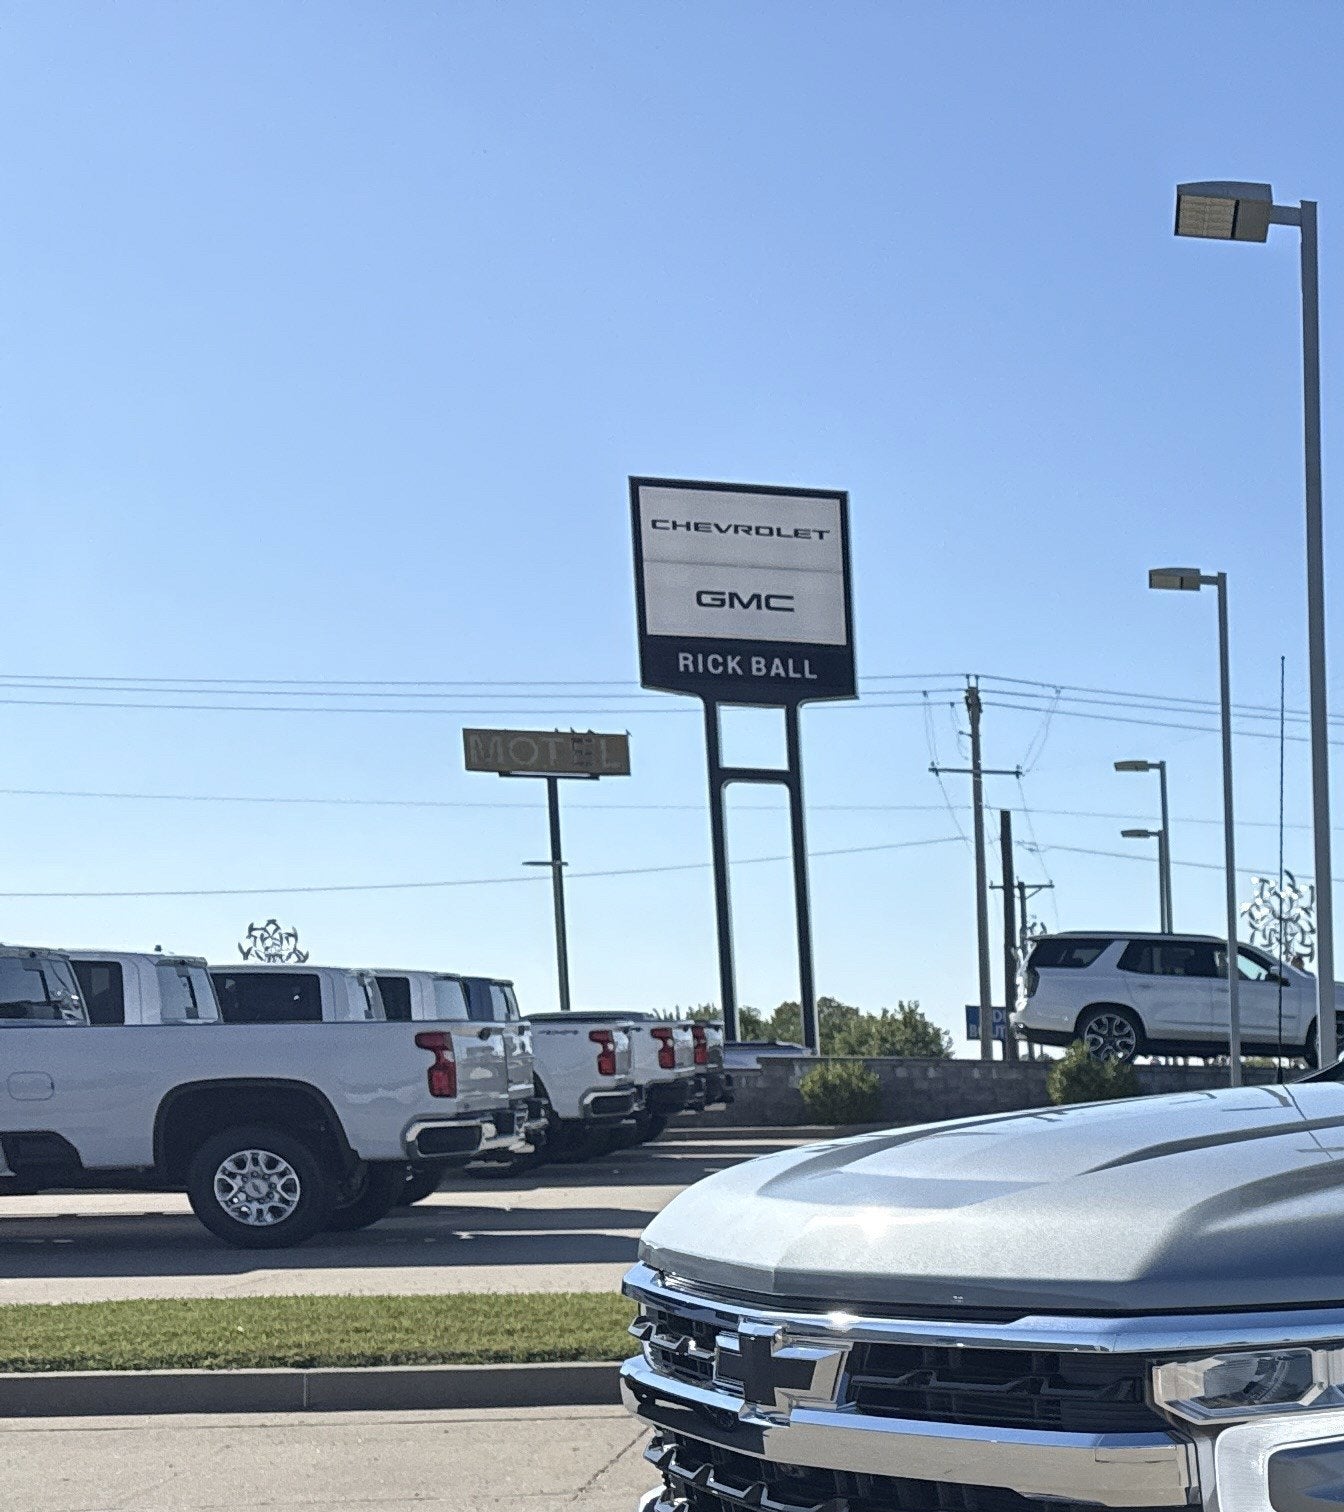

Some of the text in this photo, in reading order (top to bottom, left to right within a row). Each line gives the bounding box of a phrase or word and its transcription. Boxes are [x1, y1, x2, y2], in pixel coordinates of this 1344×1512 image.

[651, 519, 830, 540] CHEVROLET
[696, 590, 795, 612] GMC
[678, 652, 818, 680] RICK BALL
[469, 734, 625, 770] MOTEL
